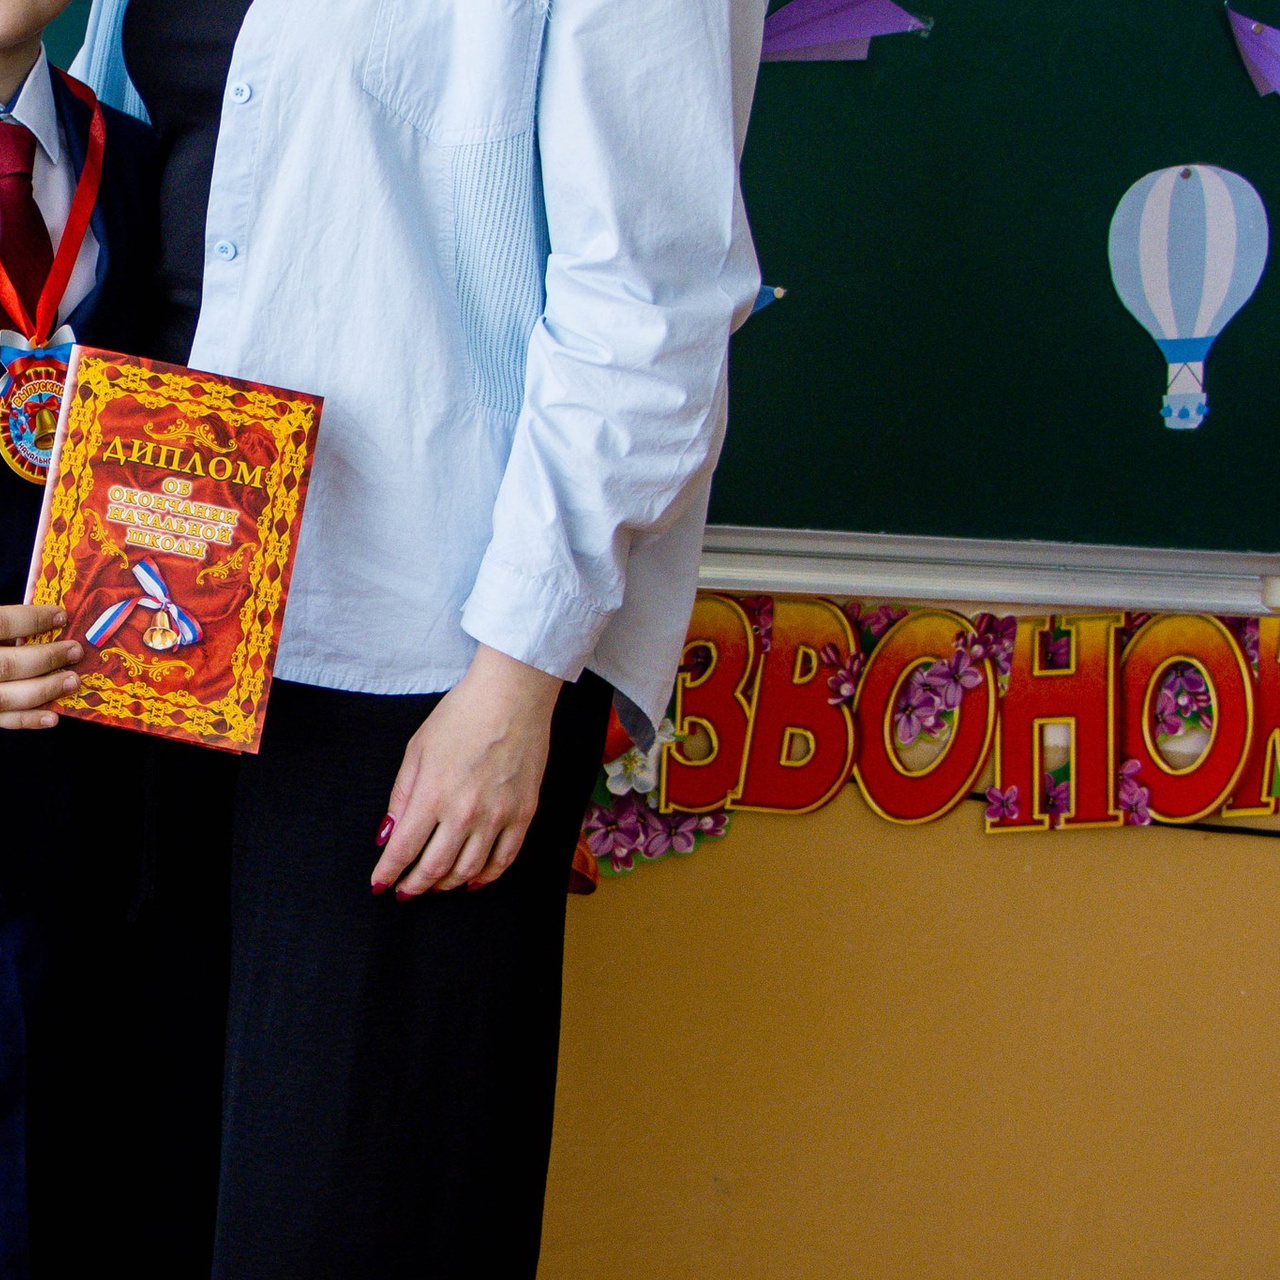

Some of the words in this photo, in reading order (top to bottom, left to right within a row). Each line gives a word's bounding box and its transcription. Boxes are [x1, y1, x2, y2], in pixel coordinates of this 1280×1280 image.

[102, 434, 267, 490] ДИПЛОМ
[109, 486, 238, 527] ОКОНЧАНИИ
[163, 477, 191, 496] ОБ
[108, 505, 232, 545] НАЧАЛЬНОЙ
[126, 528, 207, 559] ШКОЛЫ
